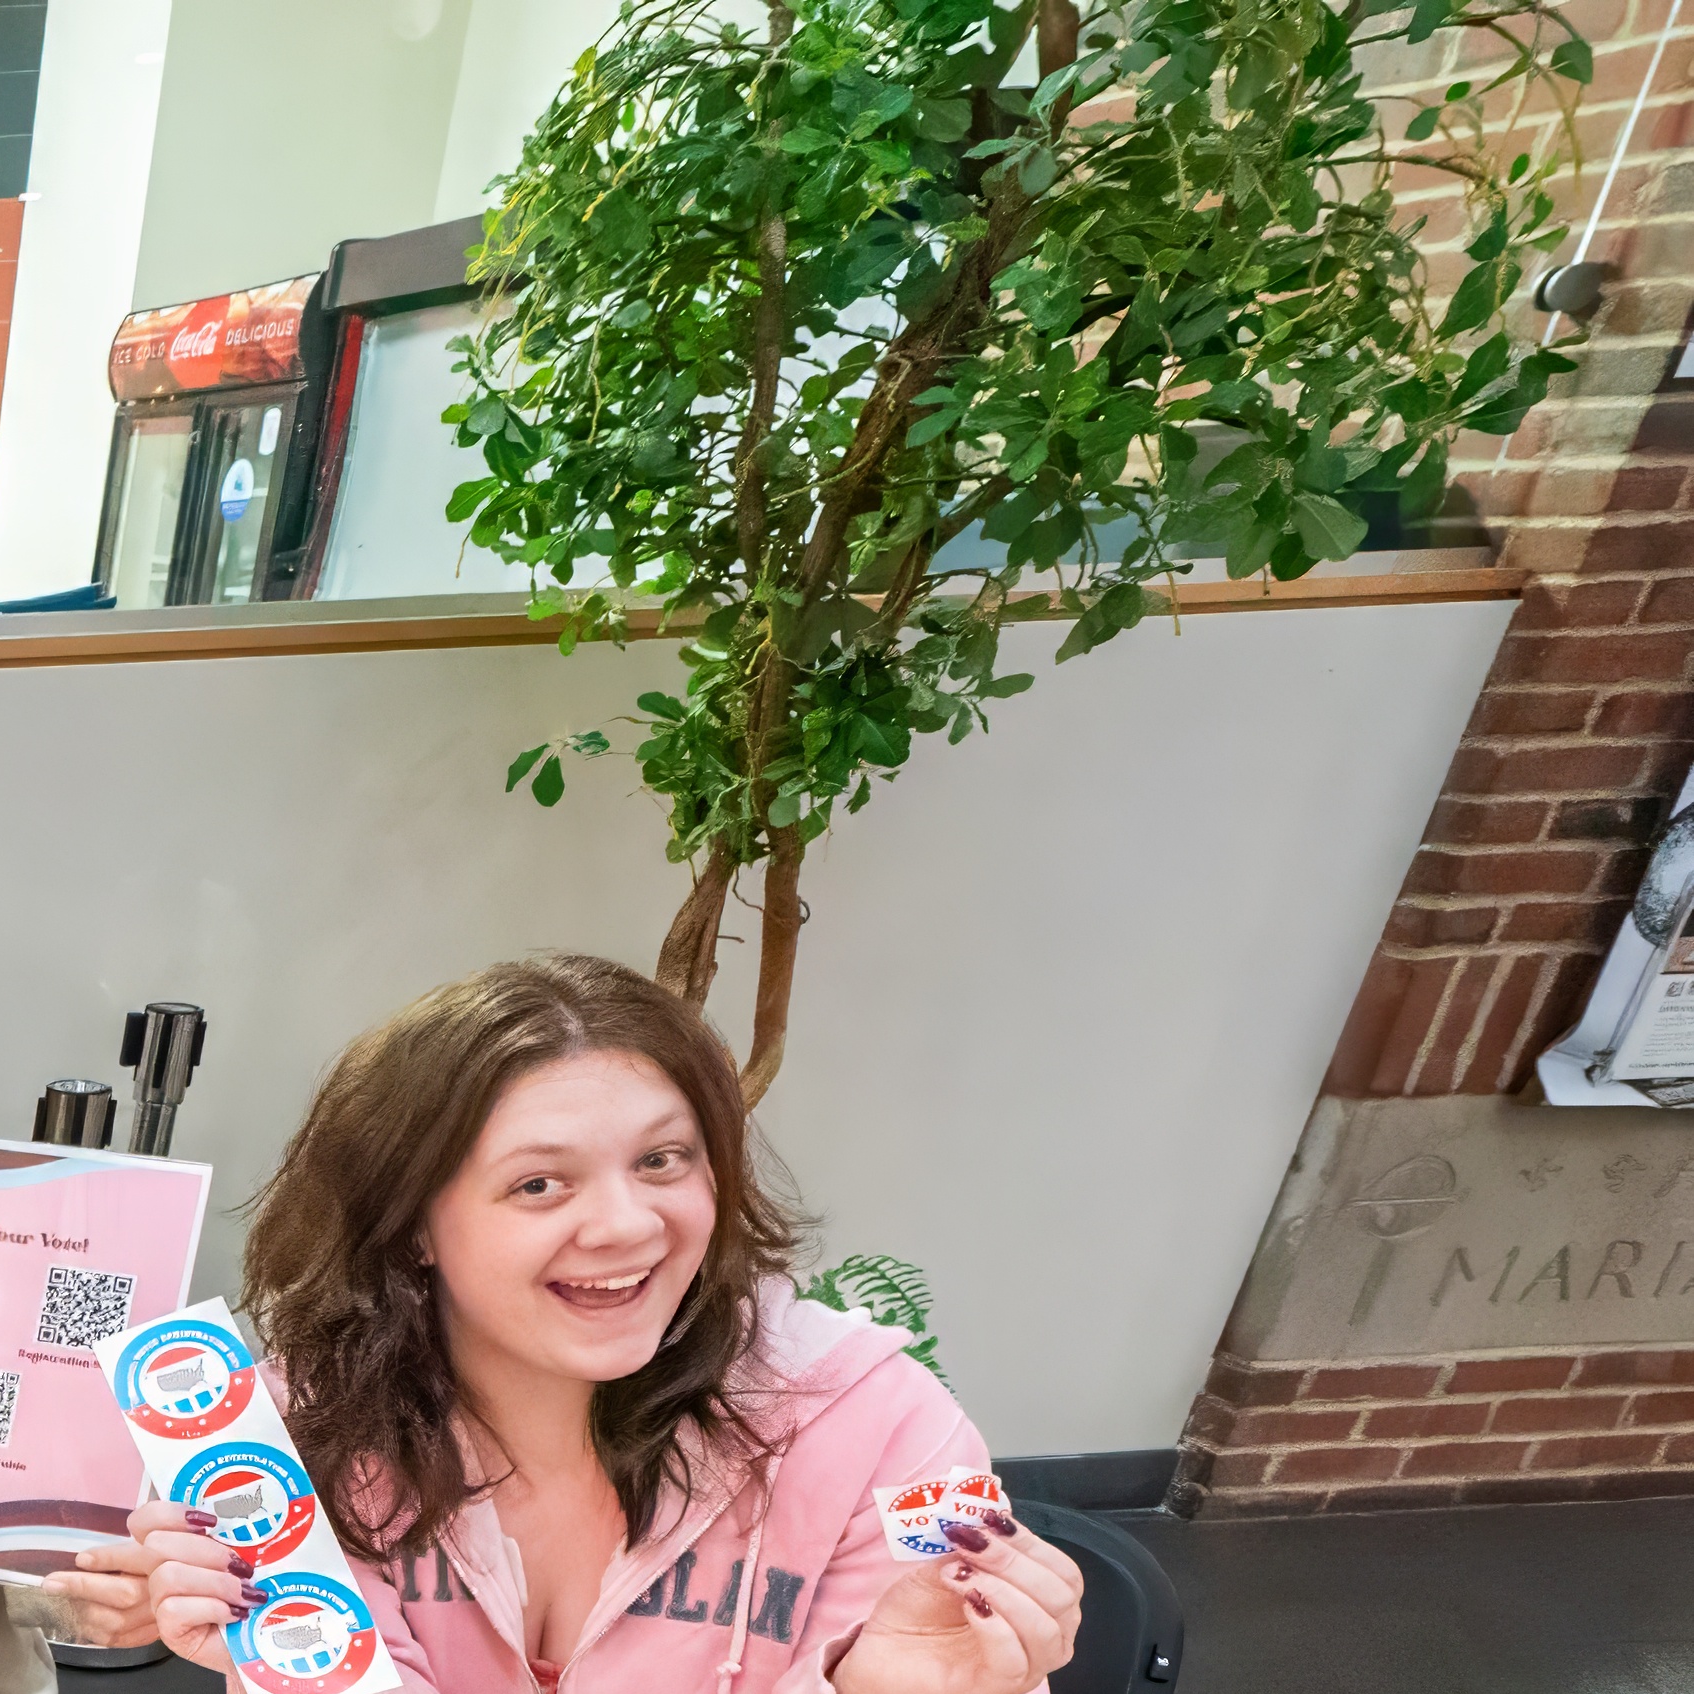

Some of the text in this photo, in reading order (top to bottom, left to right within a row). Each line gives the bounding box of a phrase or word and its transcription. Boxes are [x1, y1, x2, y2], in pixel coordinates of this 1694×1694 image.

[113, 348, 131, 364] ICE
[225, 318, 295, 346] DELICIOUS
[40, 1233, 89, 1253] Vote!
